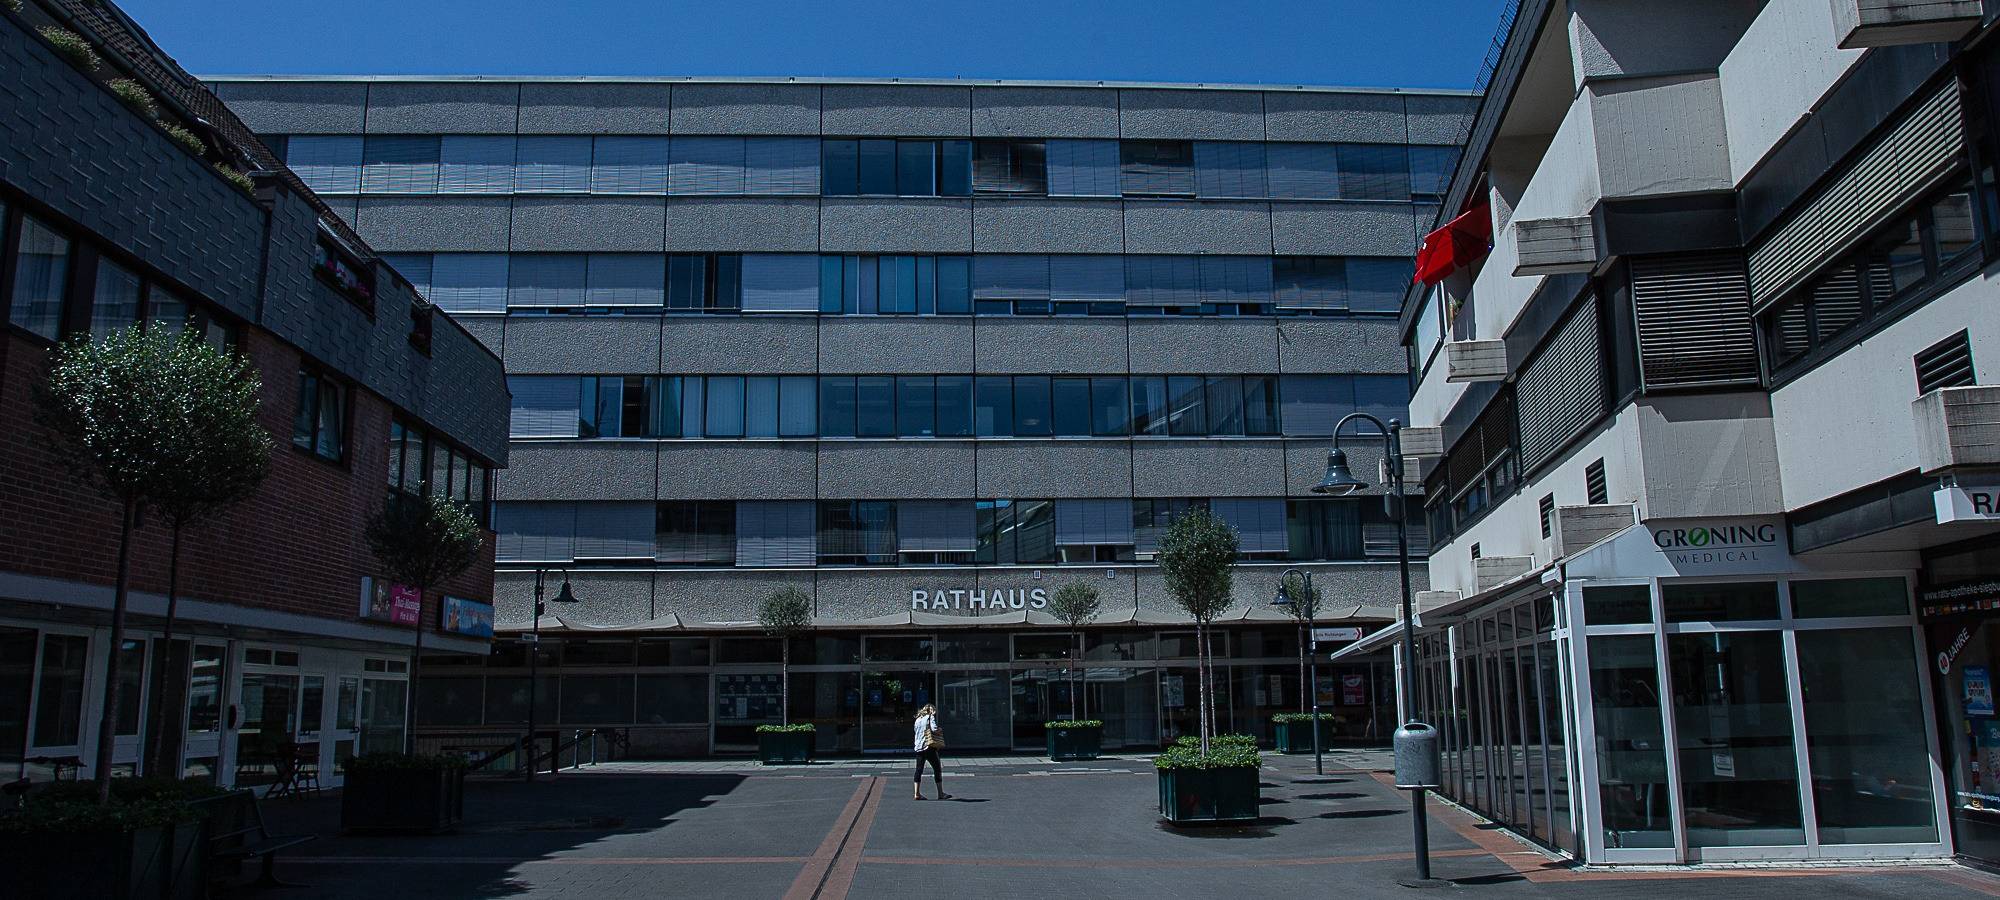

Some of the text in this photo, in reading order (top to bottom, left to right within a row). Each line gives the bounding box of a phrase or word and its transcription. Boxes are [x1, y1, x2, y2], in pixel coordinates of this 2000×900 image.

[1972, 491, 2000, 514] R
[1676, 551, 1759, 563] MEDICAL
[912, 588, 1047, 610] RATHAUS
[1948, 626, 1970, 662] JAHRE
